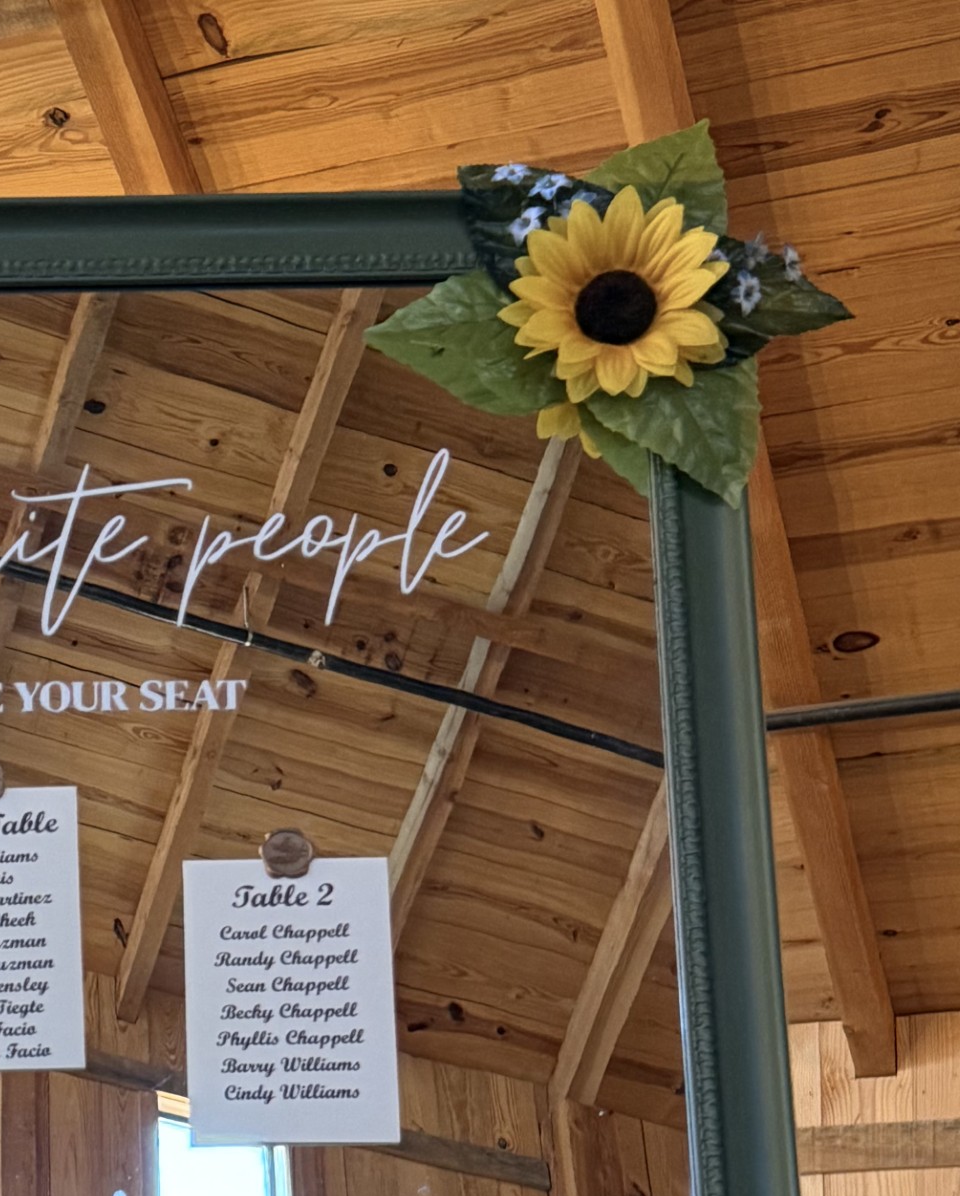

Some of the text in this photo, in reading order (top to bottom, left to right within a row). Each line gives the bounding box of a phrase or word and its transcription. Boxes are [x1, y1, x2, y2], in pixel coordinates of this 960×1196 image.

[176, 448, 490, 627] people
[14, 680, 130, 714] YOUR
[139, 679, 249, 712] SEAT
[232, 883, 334, 908] Table 2
[220, 923, 349, 943] Carol Chappell
[214, 949, 358, 970] Randy Chappell
[226, 976, 349, 996] Sean Chappell
[221, 1057, 360, 1078] Barry Williams
[224, 1084, 360, 1104] Cindy Williams
